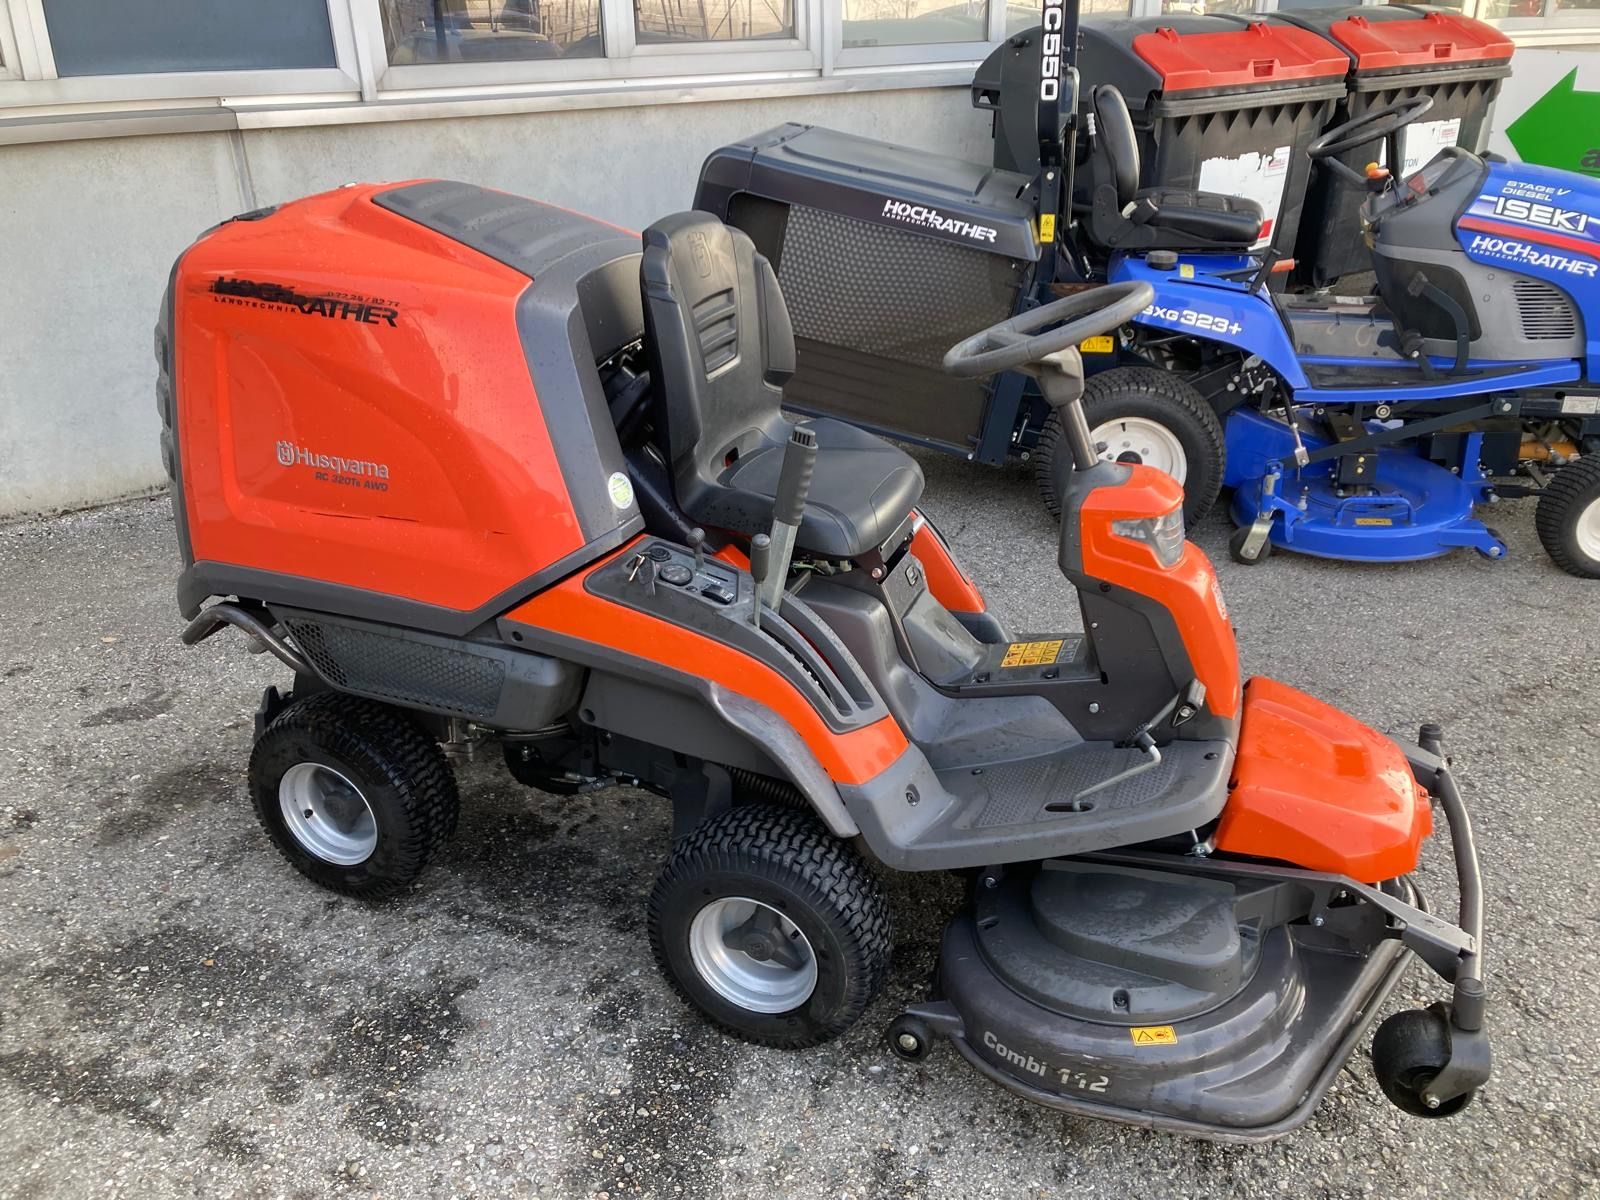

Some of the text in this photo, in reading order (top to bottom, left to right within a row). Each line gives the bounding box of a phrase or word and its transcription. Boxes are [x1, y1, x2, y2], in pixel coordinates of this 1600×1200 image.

[1041, 0, 1062, 101] C550
[1502, 187, 1553, 202] DIESEL
[1506, 180, 1574, 196] STAGE V
[883, 199, 998, 243] HOCHRATHER
[1495, 197, 1588, 232] ISEKI
[1468, 247, 1528, 264] LANDTECHNIK
[1471, 235, 1598, 277] HOCHRATHER
[213, 295, 297, 313] LANDTECHNIK
[1180, 309, 1242, 335] 323+
[295, 446, 389, 479] Husqvarna
[315, 471, 329, 481] RC
[363, 480, 389, 493] AWD
[983, 1031, 1109, 1093] Combi 112
